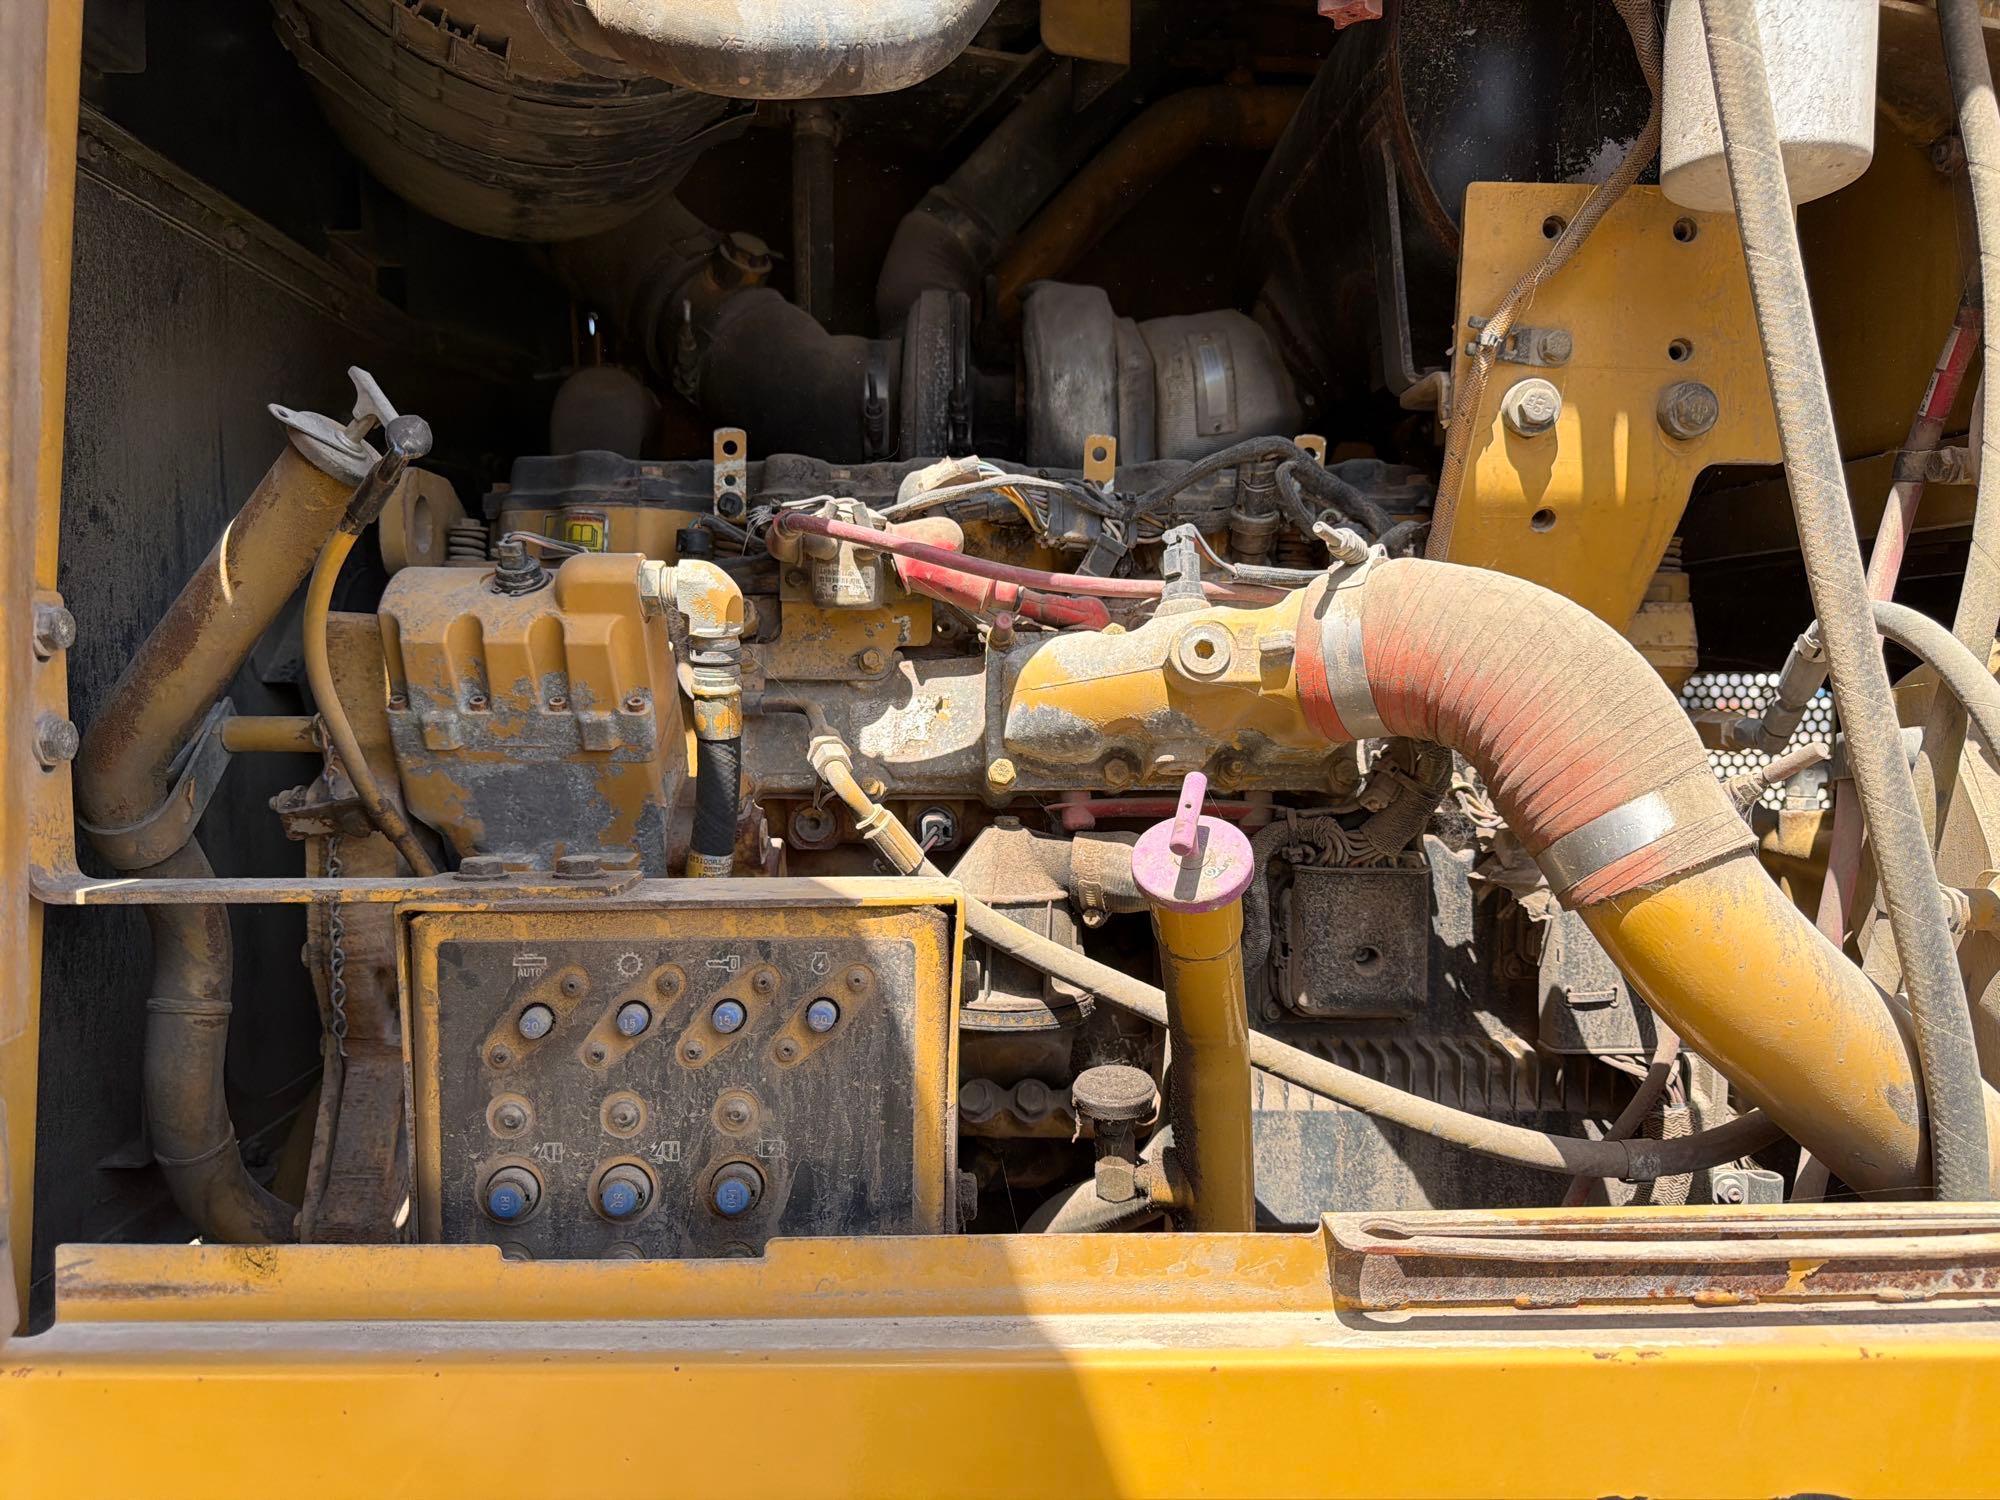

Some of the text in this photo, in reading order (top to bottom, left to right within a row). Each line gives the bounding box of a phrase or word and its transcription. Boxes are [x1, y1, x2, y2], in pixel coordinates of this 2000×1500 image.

[517, 967, 543, 978] AUTO
[623, 1019, 636, 1030] 15
[718, 1015, 732, 1026] 15
[525, 1021, 539, 1032] 20
